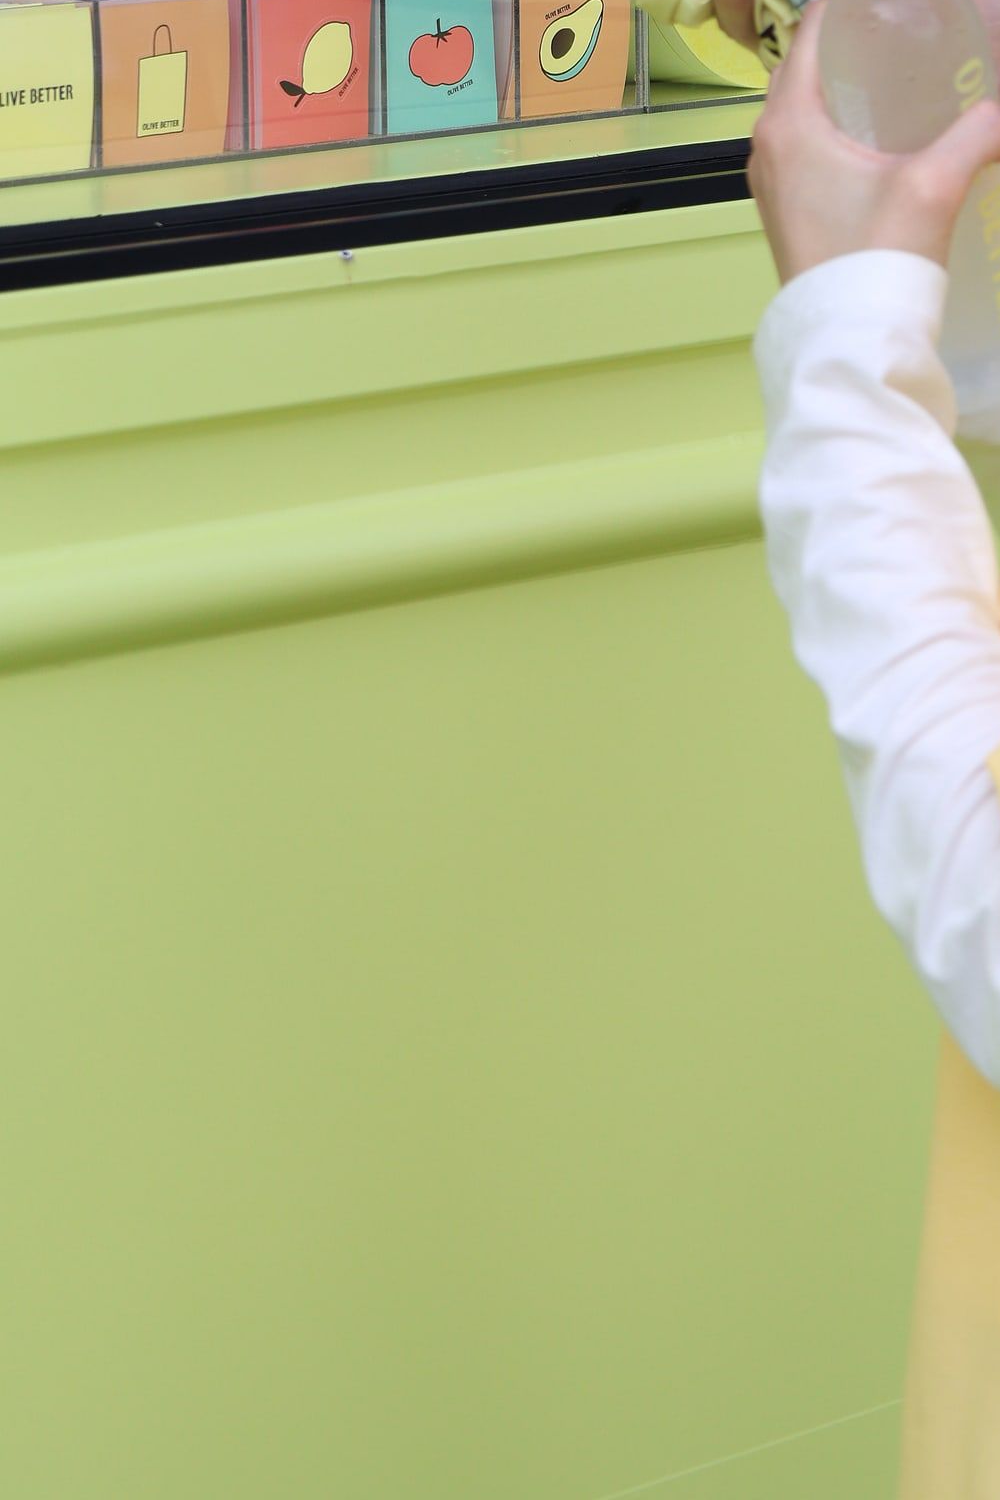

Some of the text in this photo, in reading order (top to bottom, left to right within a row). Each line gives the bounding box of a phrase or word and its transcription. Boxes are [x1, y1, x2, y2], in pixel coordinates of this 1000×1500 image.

[0, 84, 73, 107] LIVE BETTER
[447, 79, 473, 96] OLIVE BETTER
[142, 119, 179, 131] OLIVE BETTER
